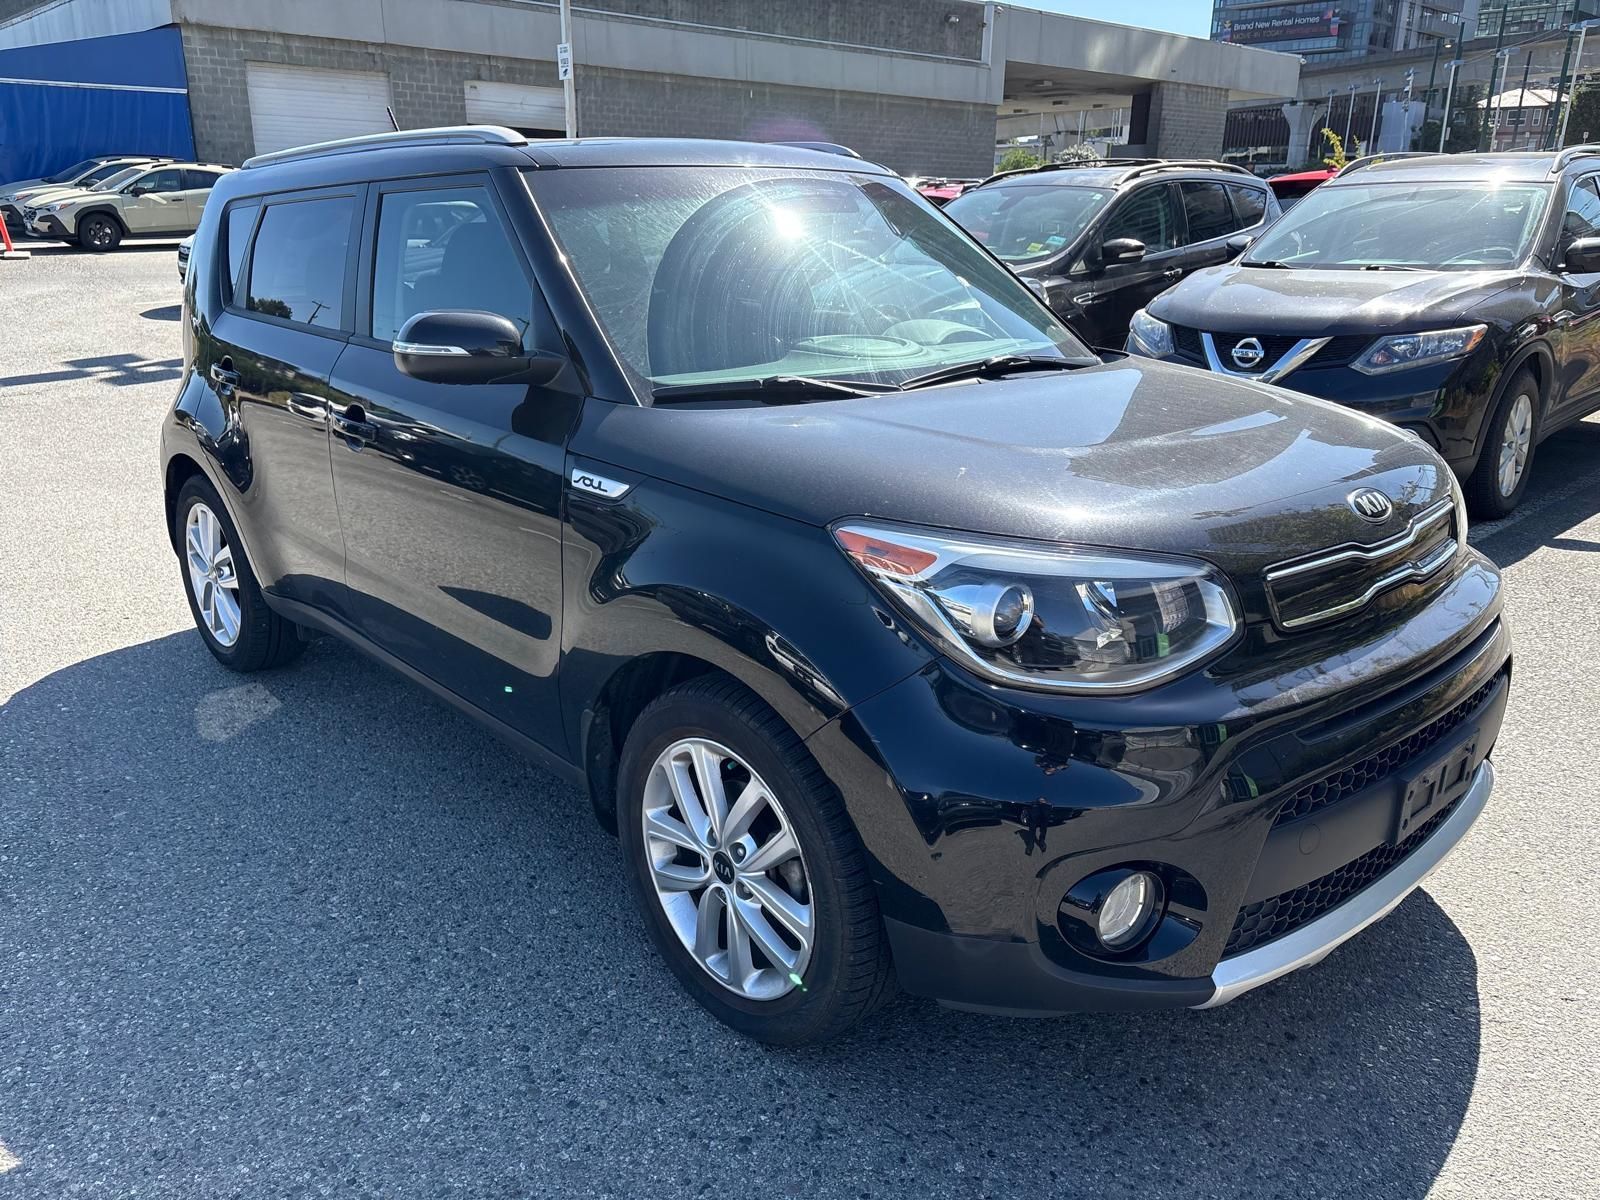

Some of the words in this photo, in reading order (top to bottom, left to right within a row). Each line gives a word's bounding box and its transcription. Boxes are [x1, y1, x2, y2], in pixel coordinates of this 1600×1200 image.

[1233, 22, 1254, 31] Brand
[1255, 21, 1271, 29] New
[1271, 17, 1294, 27] Rental
[1295, 16, 1320, 25] Homes
[573, 475, 608, 493] SOUL
[1355, 491, 1391, 516] KIA
[714, 859, 732, 878] KIA
